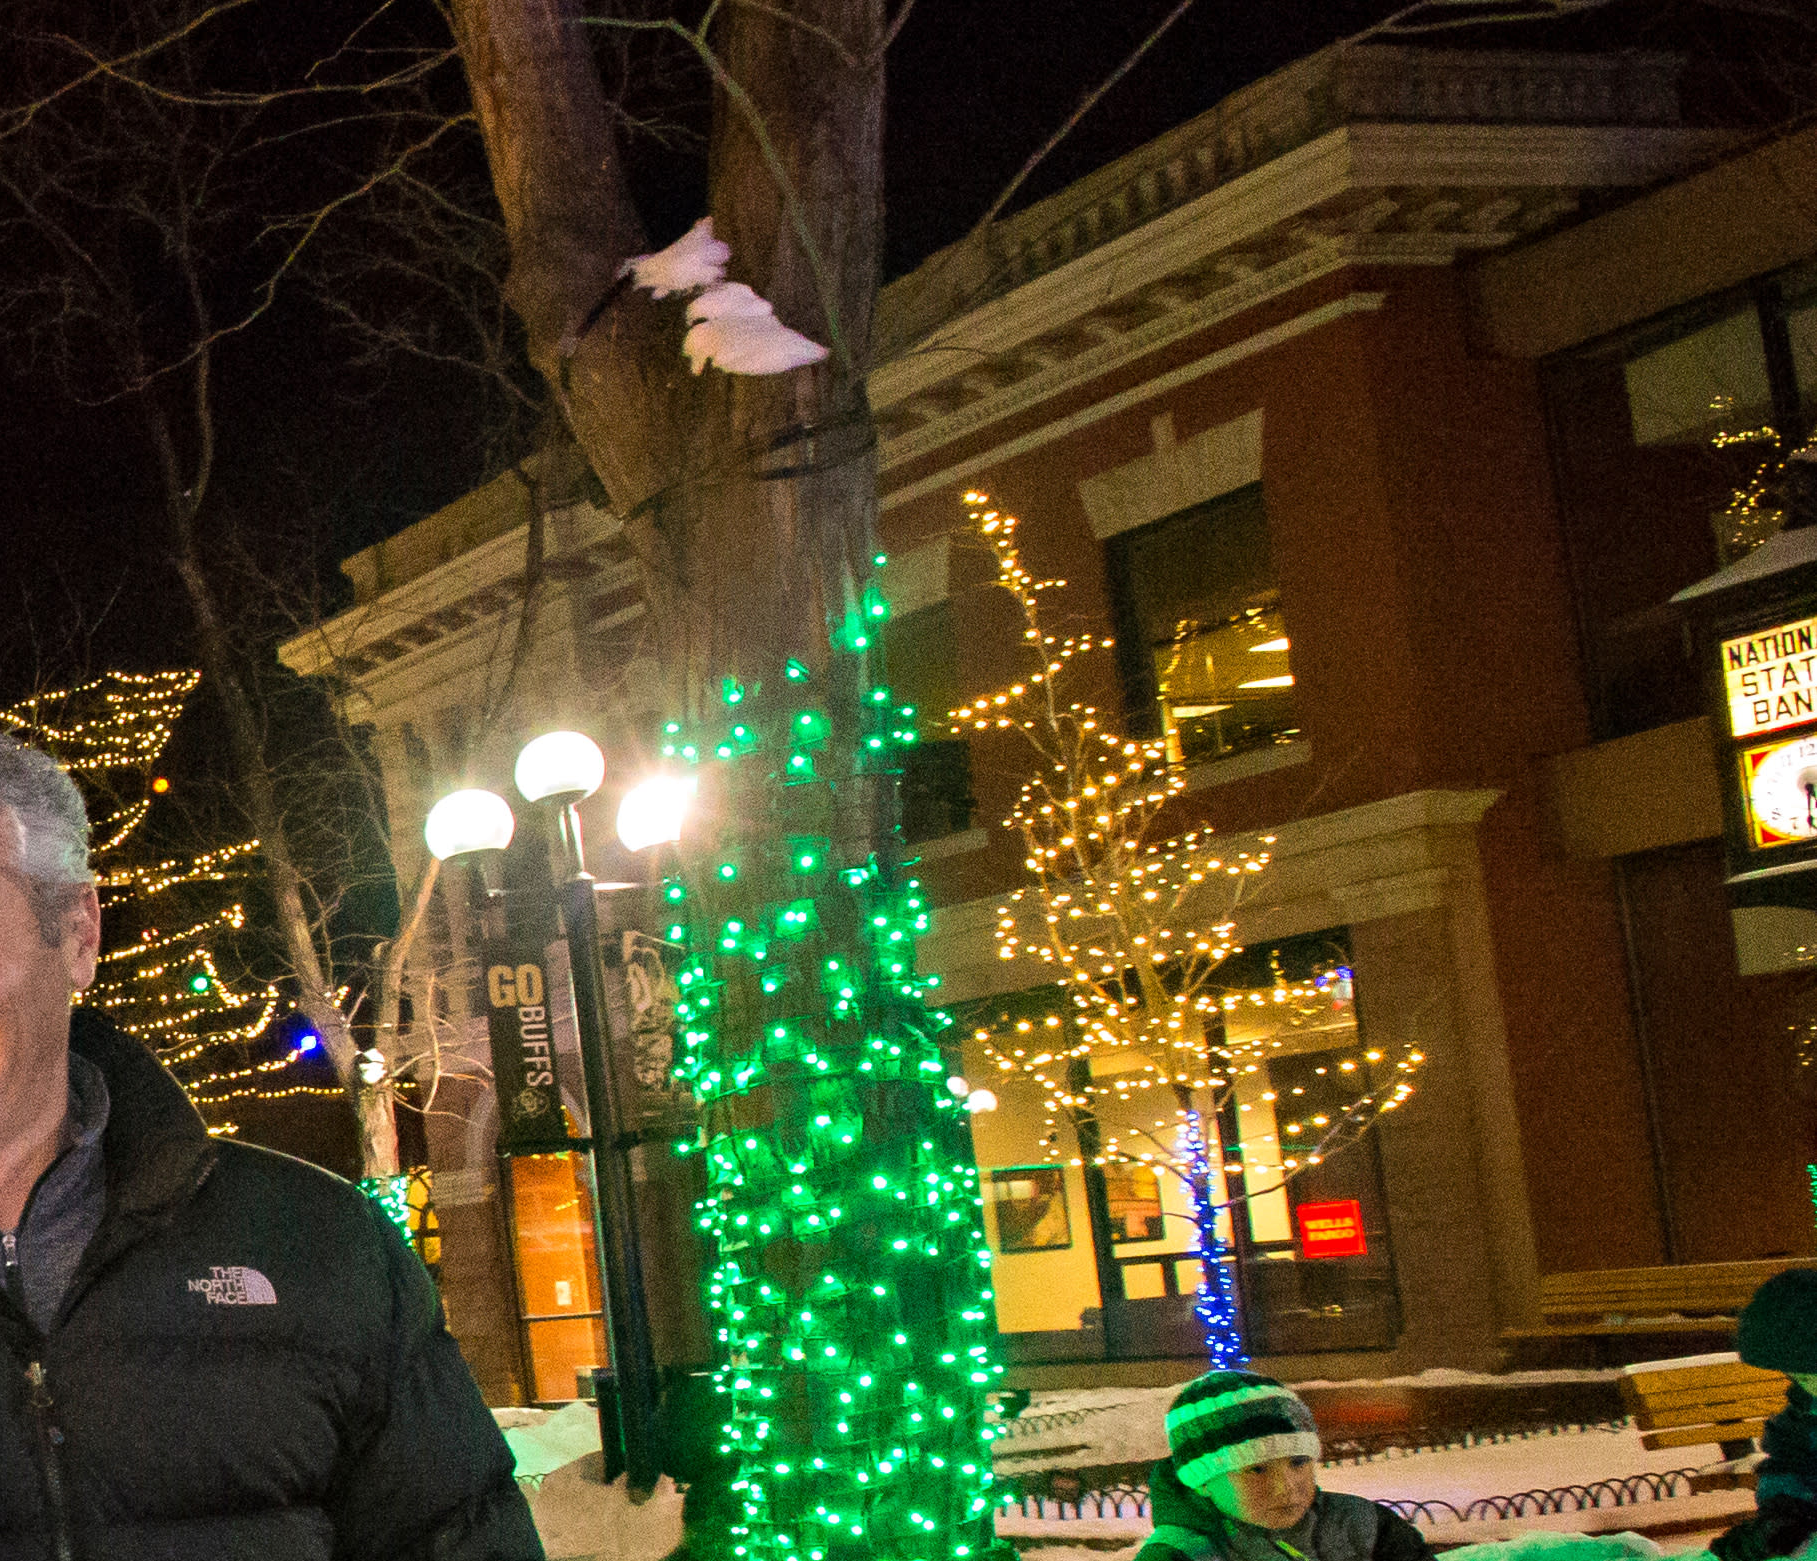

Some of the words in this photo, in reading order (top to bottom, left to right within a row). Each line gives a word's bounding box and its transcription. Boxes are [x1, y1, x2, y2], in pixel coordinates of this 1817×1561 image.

[1729, 624, 1817, 670] NATION
[1741, 655, 1817, 697] STAT
[1753, 686, 1817, 724] BAN
[488, 963, 543, 1008] GO
[518, 1006, 553, 1087] BUFFS
[1305, 1217, 1354, 1229] WELLS
[1308, 1229, 1356, 1241] FARGO
[188, 1279, 246, 1293] NORTH
[209, 1266, 243, 1280] THE
[206, 1291, 248, 1305] FACE
